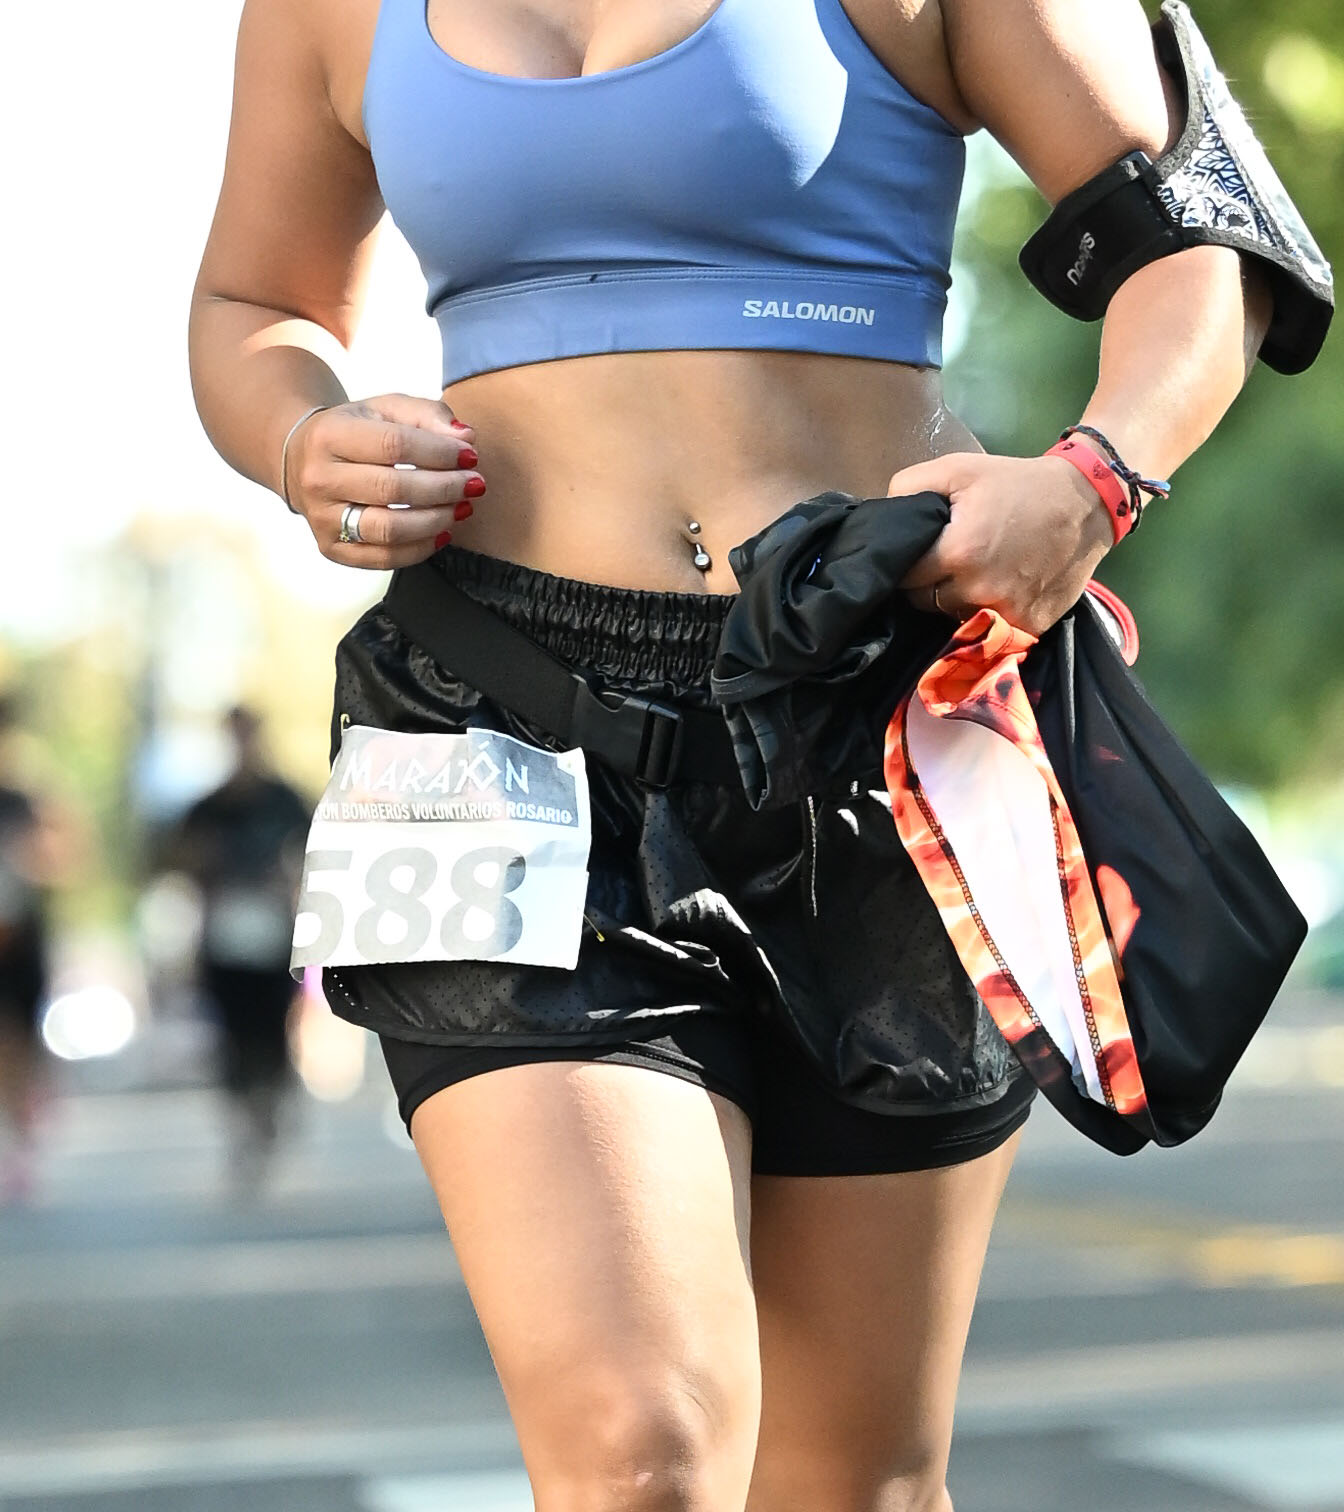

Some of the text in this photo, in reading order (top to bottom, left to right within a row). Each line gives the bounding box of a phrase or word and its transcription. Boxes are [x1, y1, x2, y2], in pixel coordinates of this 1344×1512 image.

[742, 300, 876, 326] SALOMON
[342, 801, 411, 821] BOMBEROS
[411, 800, 502, 821] VOLUNTARIOS
[506, 801, 573, 825] ROSARIO
